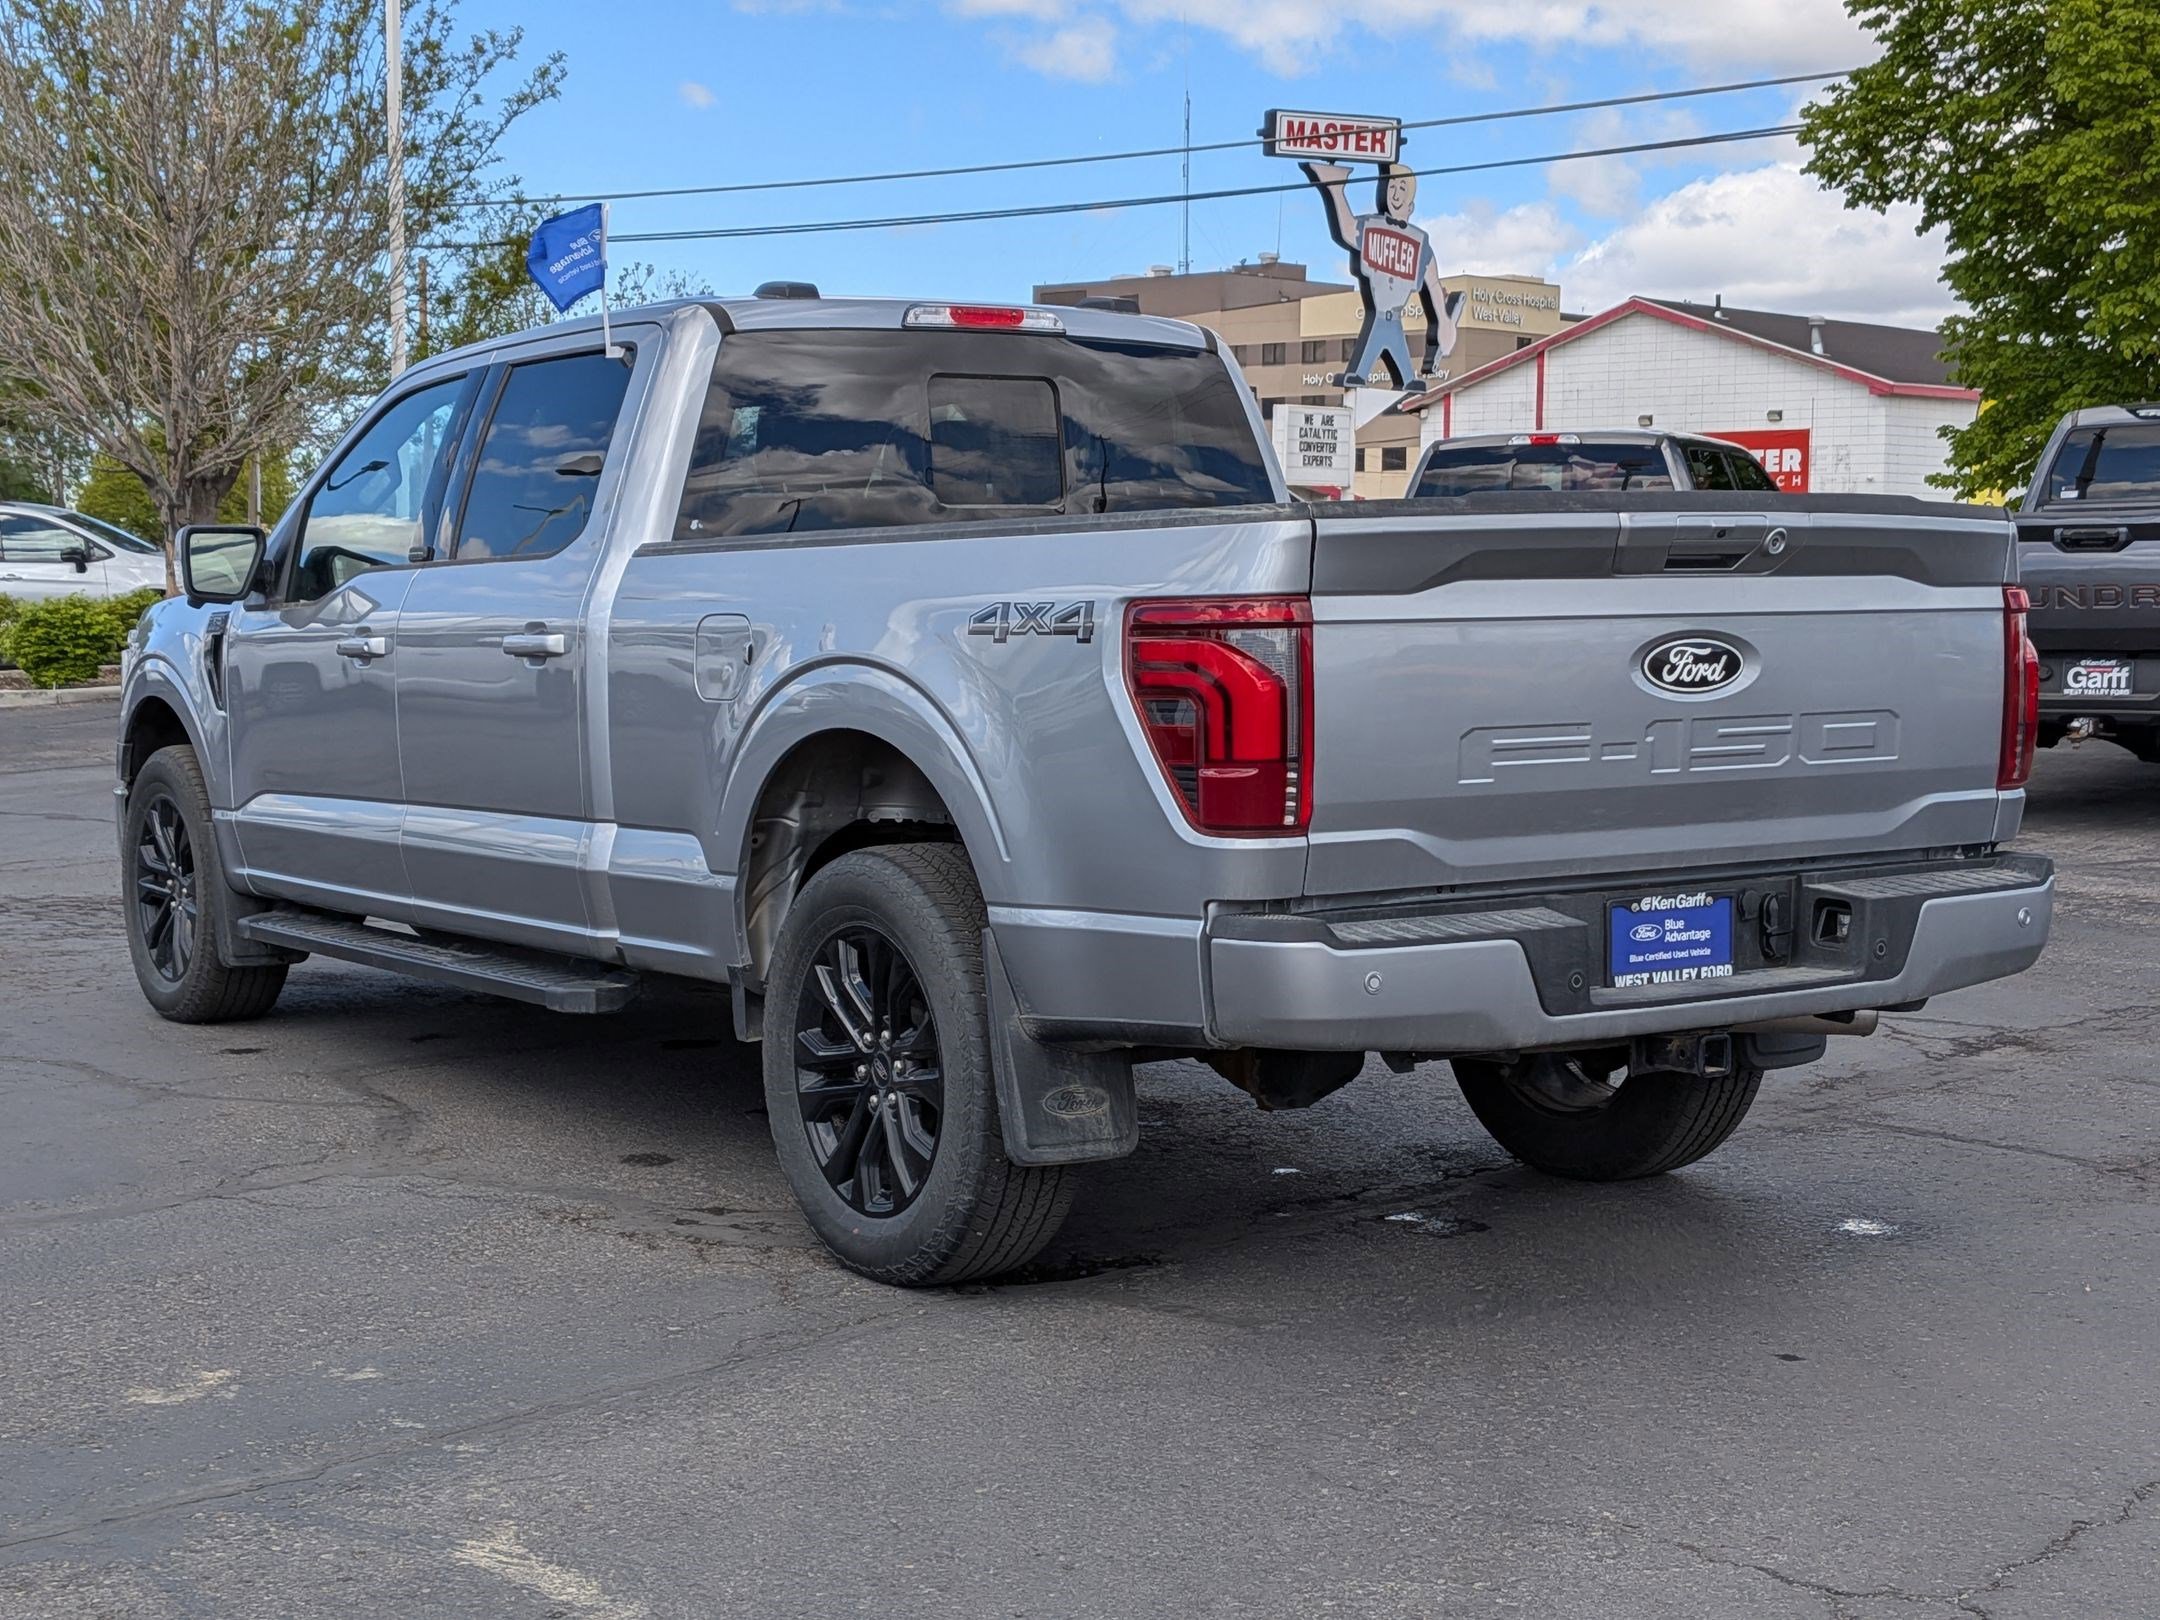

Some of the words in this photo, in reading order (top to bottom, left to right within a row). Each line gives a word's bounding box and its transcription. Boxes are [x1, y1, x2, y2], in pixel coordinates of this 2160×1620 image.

[1286, 120, 1387, 153] MASTER
[1368, 231, 1415, 275] MUFFLER
[1472, 287, 1494, 305] Holy
[1495, 289, 1521, 306] Cross
[1523, 293, 1559, 312] Hospital
[1473, 305, 1497, 322] West
[1499, 308, 1524, 327] Valley
[1302, 373, 1324, 387] Holy
[1304, 414, 1314, 426] WE
[1321, 415, 1335, 427] ARE
[1299, 427, 1338, 440] CATALYTIC
[1299, 441, 1337, 454] CONVERTER
[1302, 455, 1333, 467] EXPERTS
[1662, 646, 1728, 683] Ford
[2066, 666, 2130, 689] Garff
[1457, 710, 1900, 784] F-150
[1635, 926, 1657, 939] Ford
[1664, 919, 1685, 931] Blue
[1664, 929, 1711, 943] Advantage
[1629, 953, 1644, 963] Blue
[1644, 951, 1672, 961] Certified
[1672, 950, 1689, 958] Used
[1690, 947, 1711, 956] Vehicle
[1614, 972, 1650, 988] WEST
[1652, 967, 1698, 984] VALLEY
[1700, 964, 1733, 979] FORD
